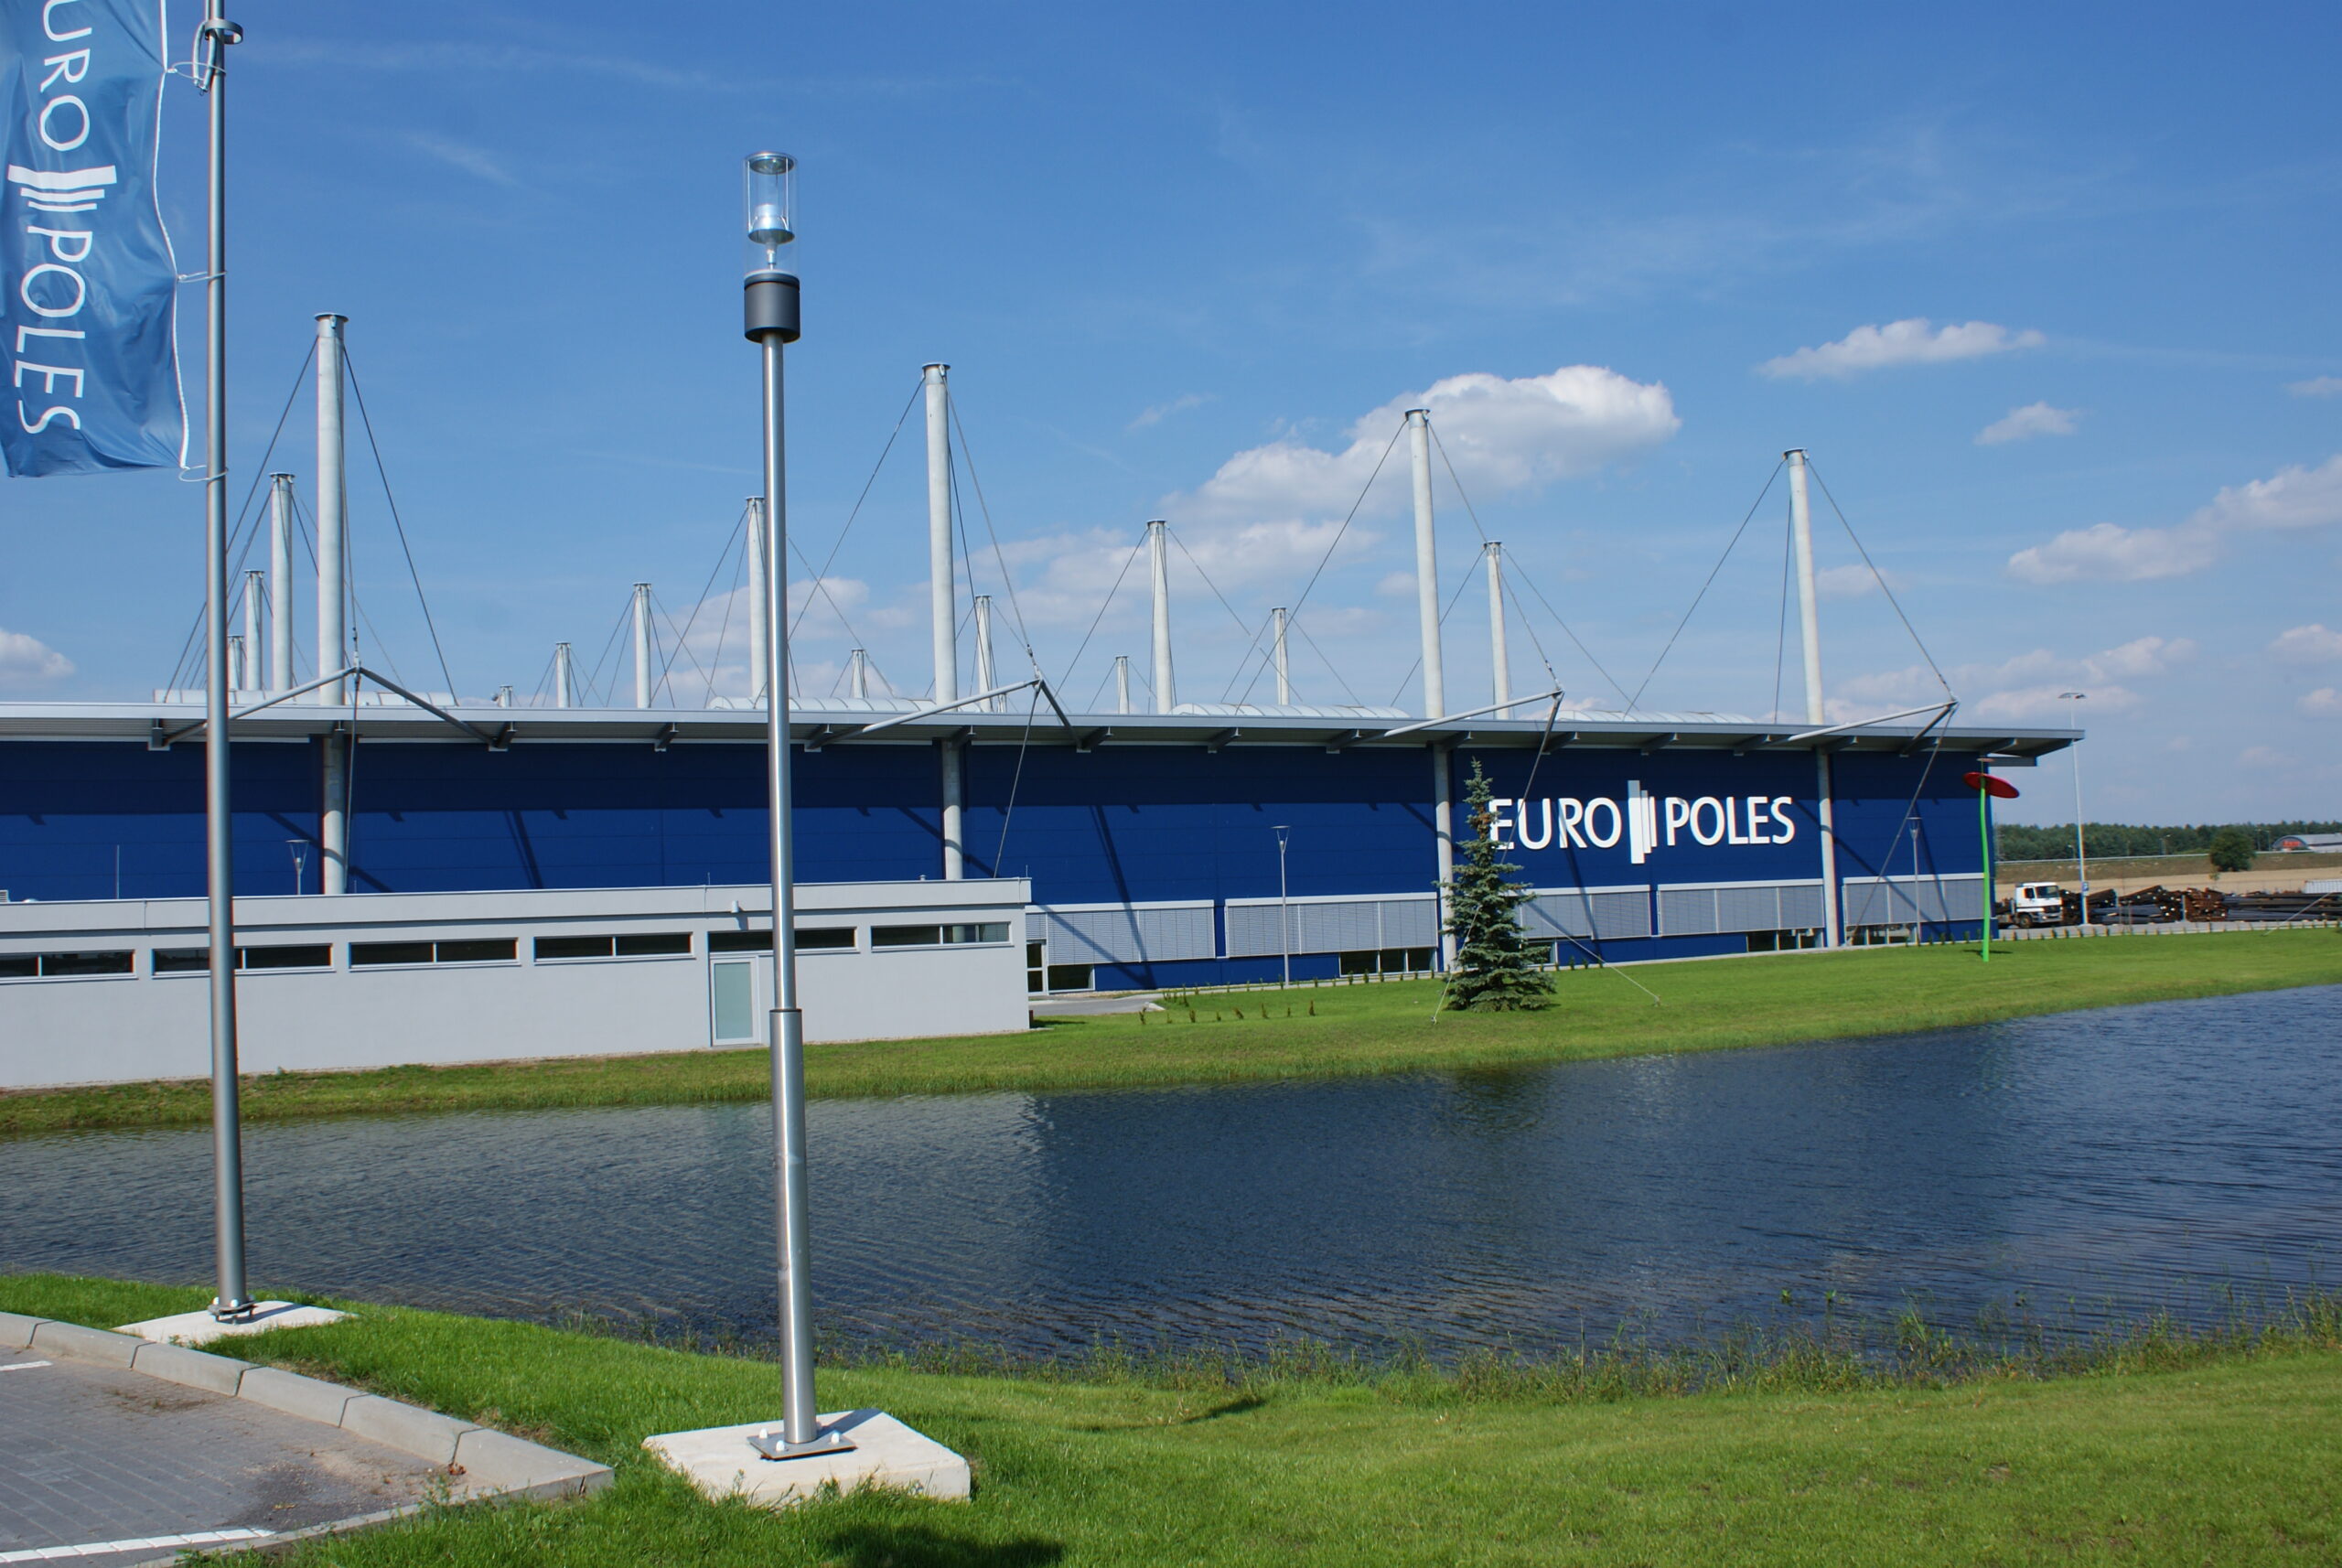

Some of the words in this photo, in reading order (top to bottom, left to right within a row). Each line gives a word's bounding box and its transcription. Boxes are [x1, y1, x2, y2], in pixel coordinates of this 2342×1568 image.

[14, 224, 92, 434] POLES
[1488, 797, 1623, 850] EURO
[1665, 796, 1796, 846] POLES
